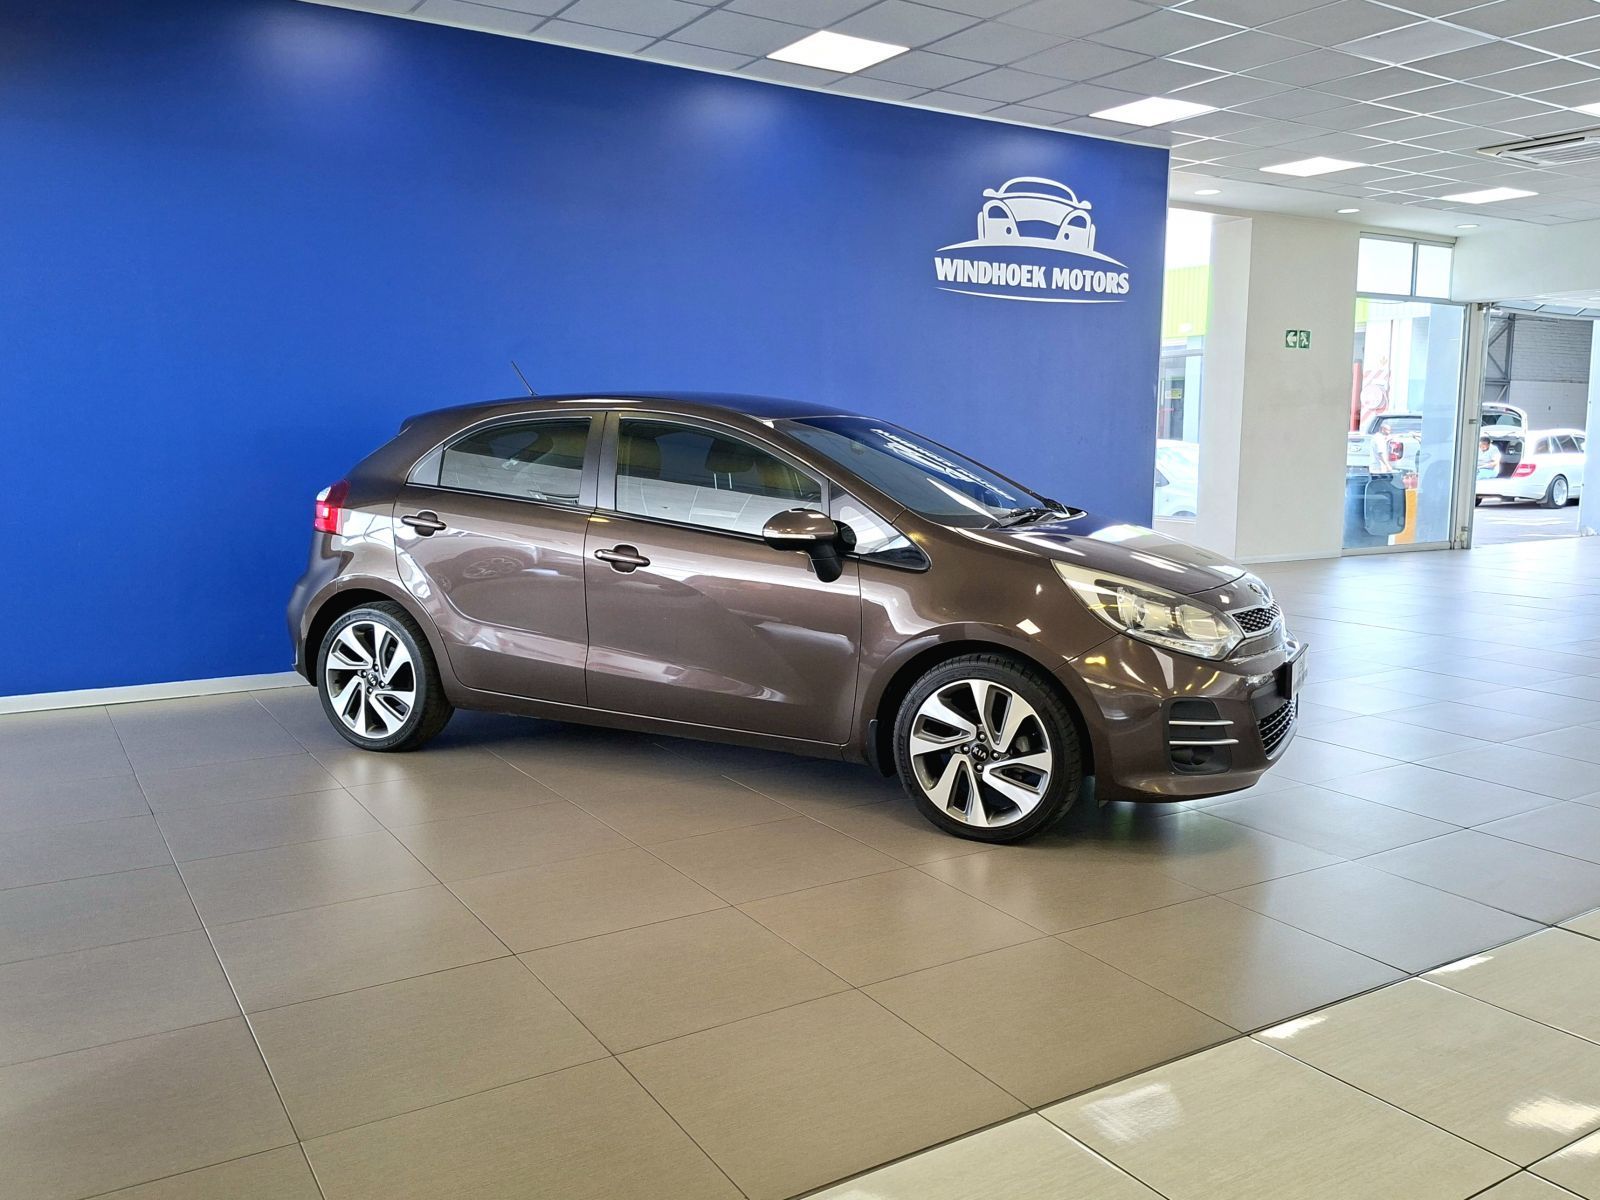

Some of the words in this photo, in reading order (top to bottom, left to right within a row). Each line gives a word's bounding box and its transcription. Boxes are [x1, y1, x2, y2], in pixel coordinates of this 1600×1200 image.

[934, 257, 1046, 288] WINDHOEK
[1052, 267, 1129, 294] MOTORS
[972, 747, 987, 760] KIA
